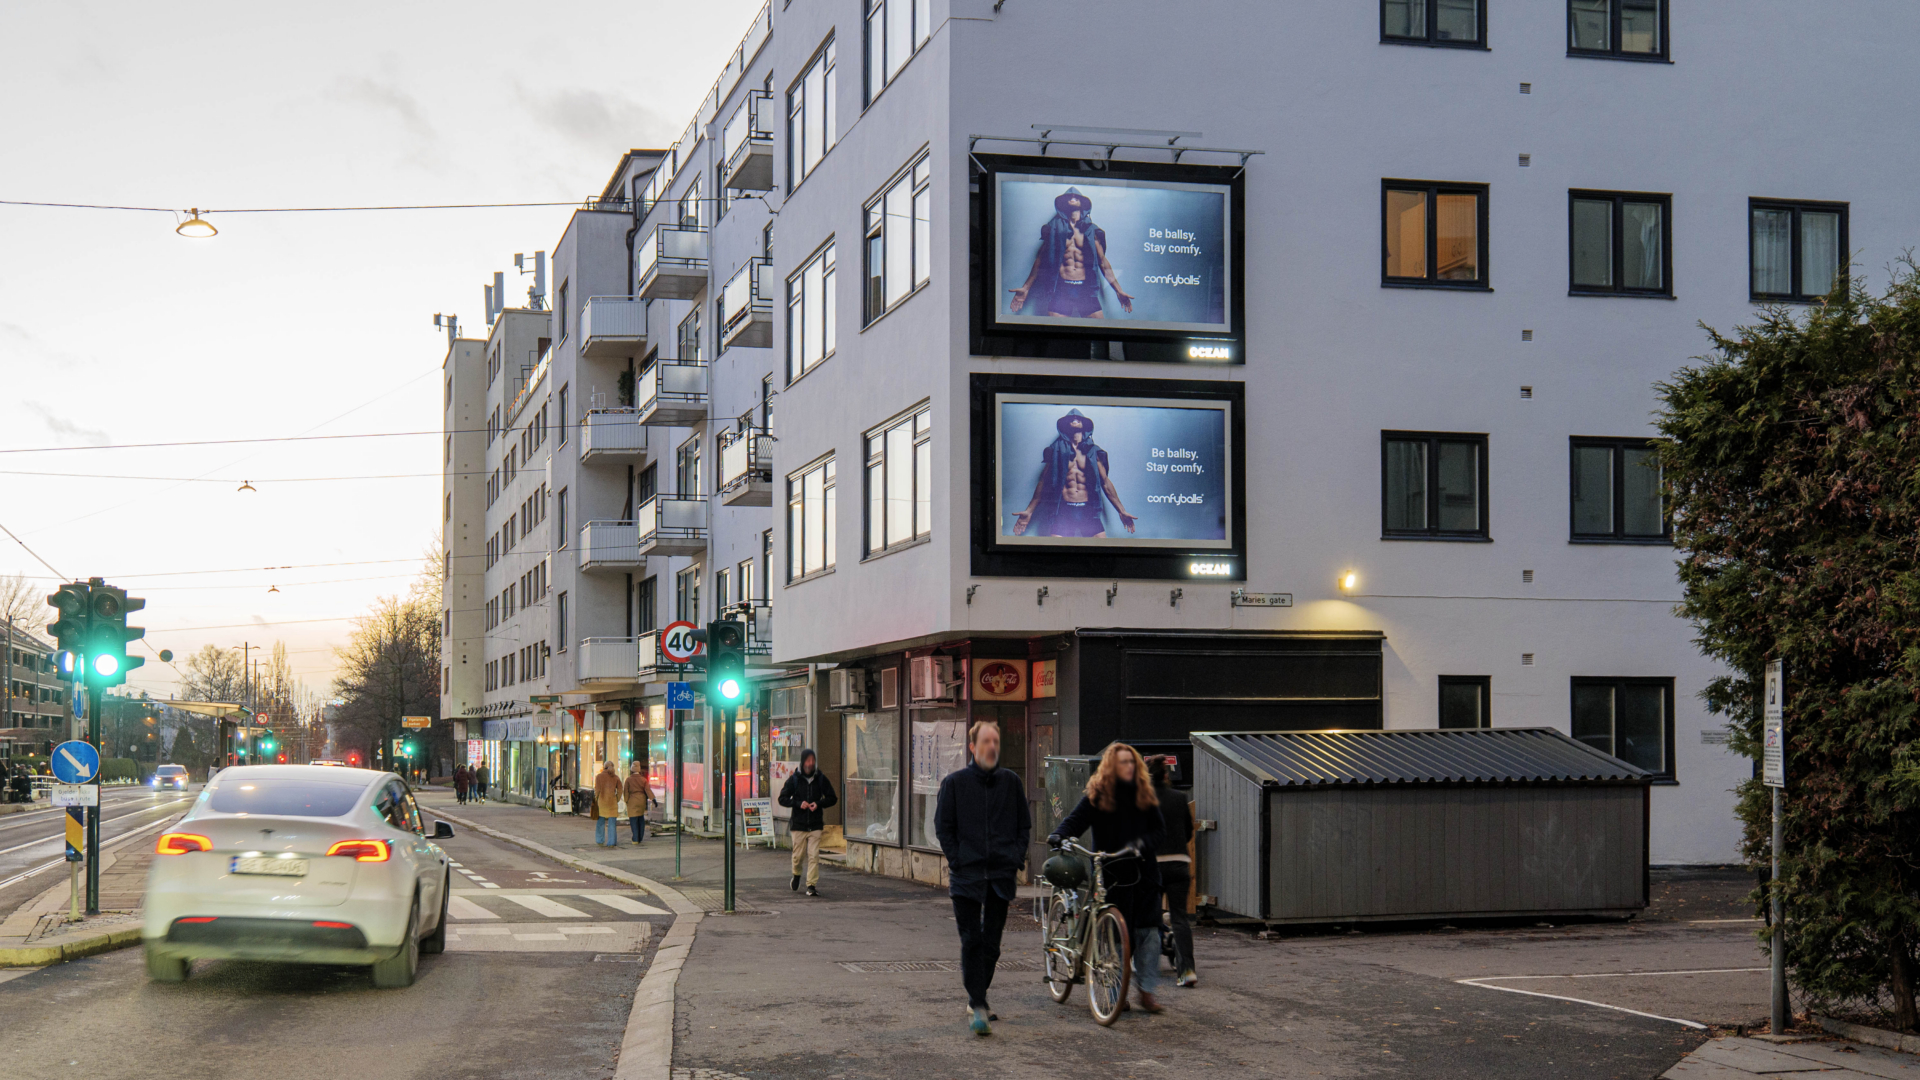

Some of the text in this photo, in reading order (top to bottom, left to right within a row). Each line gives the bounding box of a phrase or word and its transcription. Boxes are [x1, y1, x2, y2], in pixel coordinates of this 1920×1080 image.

[1149, 227, 1197, 242] Be ballsy.
[1143, 242, 1202, 256] Stay comfy.
[1143, 273, 1201, 287] comfyballs
[1189, 346, 1229, 359] OCEAN
[1151, 447, 1199, 461] Be ballsy.
[1146, 461, 1205, 475] Stay comfy.
[1147, 493, 1204, 506] comfyballs
[1190, 563, 1231, 576] OCEAN
[1242, 595, 1286, 606] Maries gate
[668, 632, 697, 652] 40
